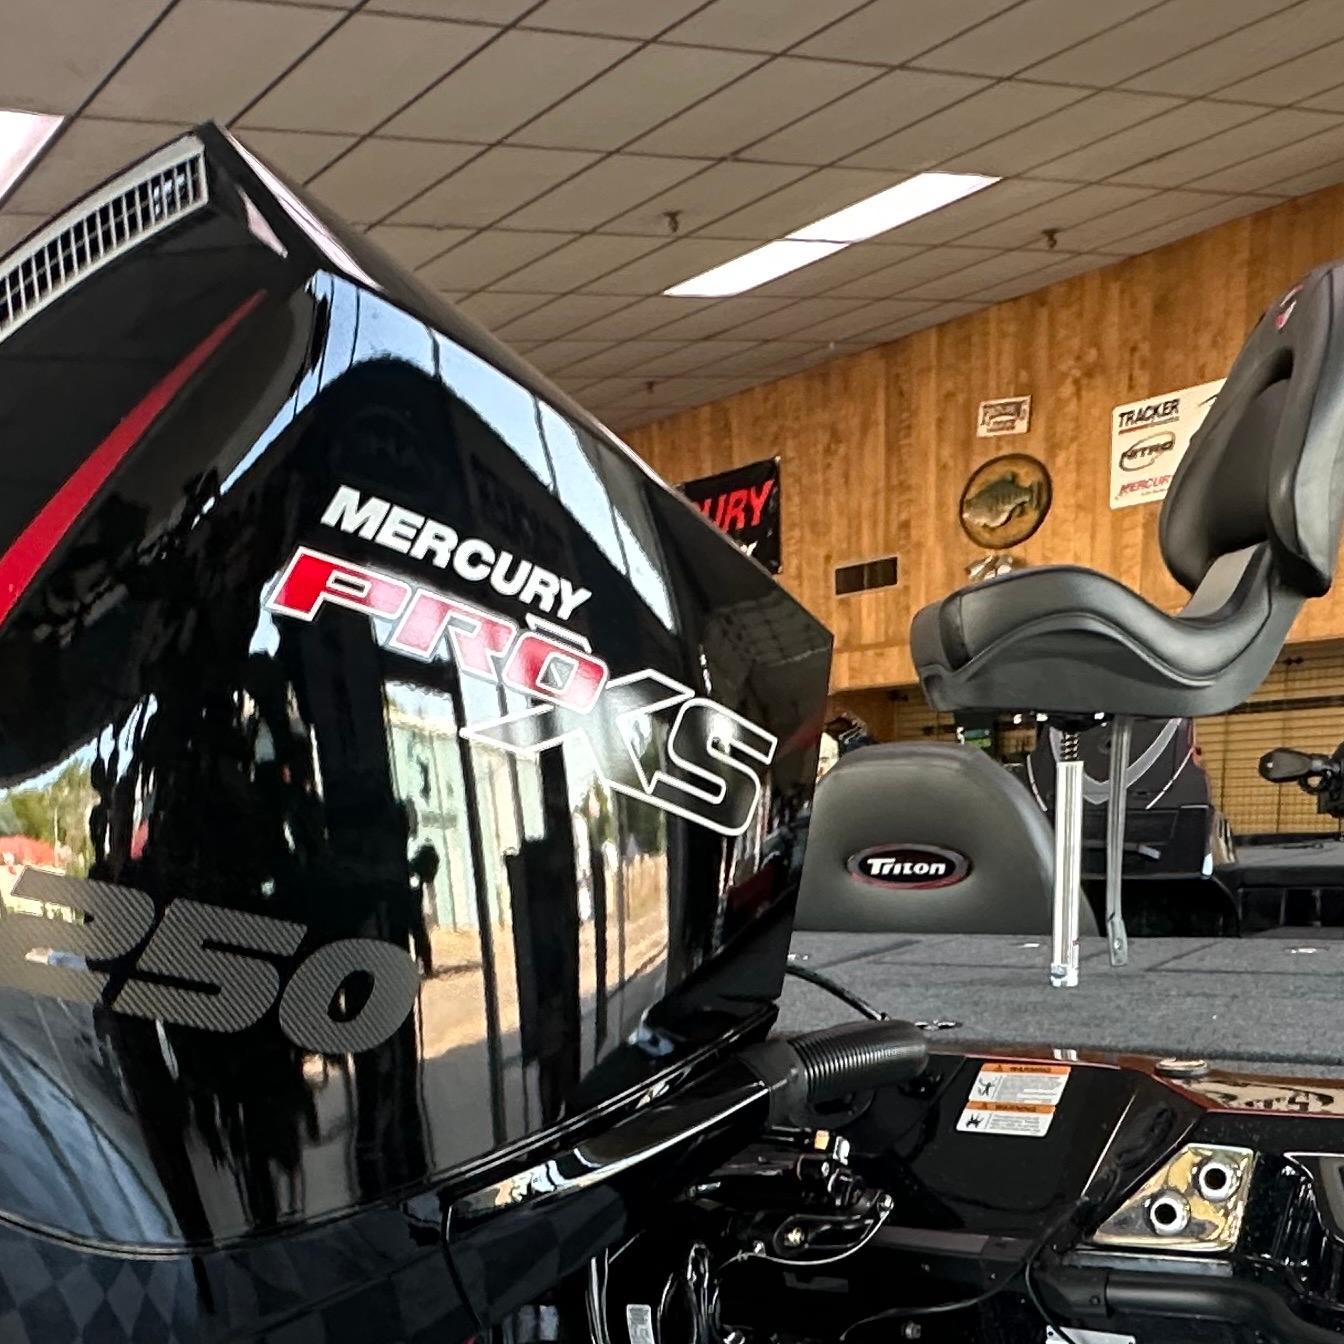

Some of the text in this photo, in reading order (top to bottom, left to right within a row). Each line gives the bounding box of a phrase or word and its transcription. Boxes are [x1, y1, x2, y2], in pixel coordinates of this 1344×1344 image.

[1119, 399, 1181, 428] TRACKER
[696, 479, 774, 532] URY
[1119, 475, 1175, 497] MERCUR
[321, 485, 592, 622] MERCURY
[264, 546, 778, 837] PRO XS
[866, 857, 947, 876] Triton
